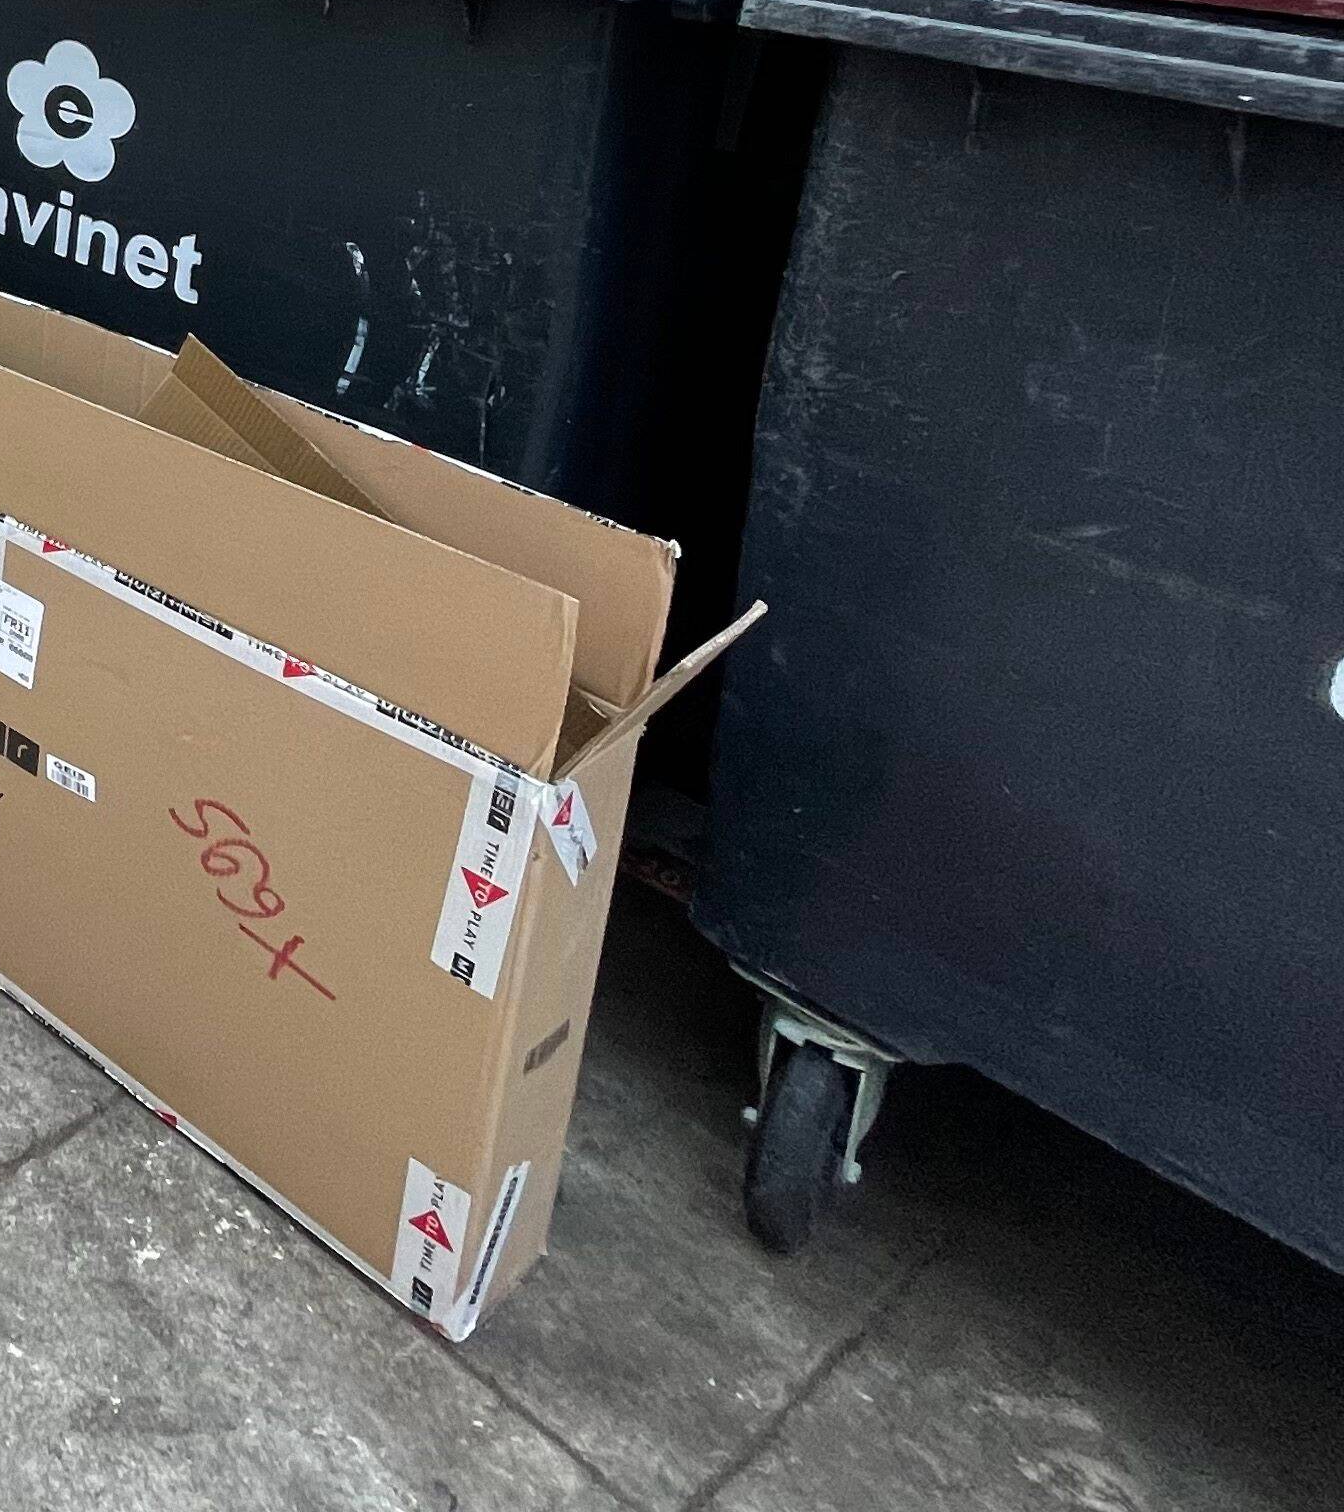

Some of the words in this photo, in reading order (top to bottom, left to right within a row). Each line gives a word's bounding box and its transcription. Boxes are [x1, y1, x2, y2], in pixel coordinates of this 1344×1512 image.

[480, 840, 500, 879] TIME
[475, 881, 493, 903] TO
[463, 910, 482, 951] PLAY
[425, 1215, 440, 1236] TO
[419, 1239, 437, 1273] TIME
